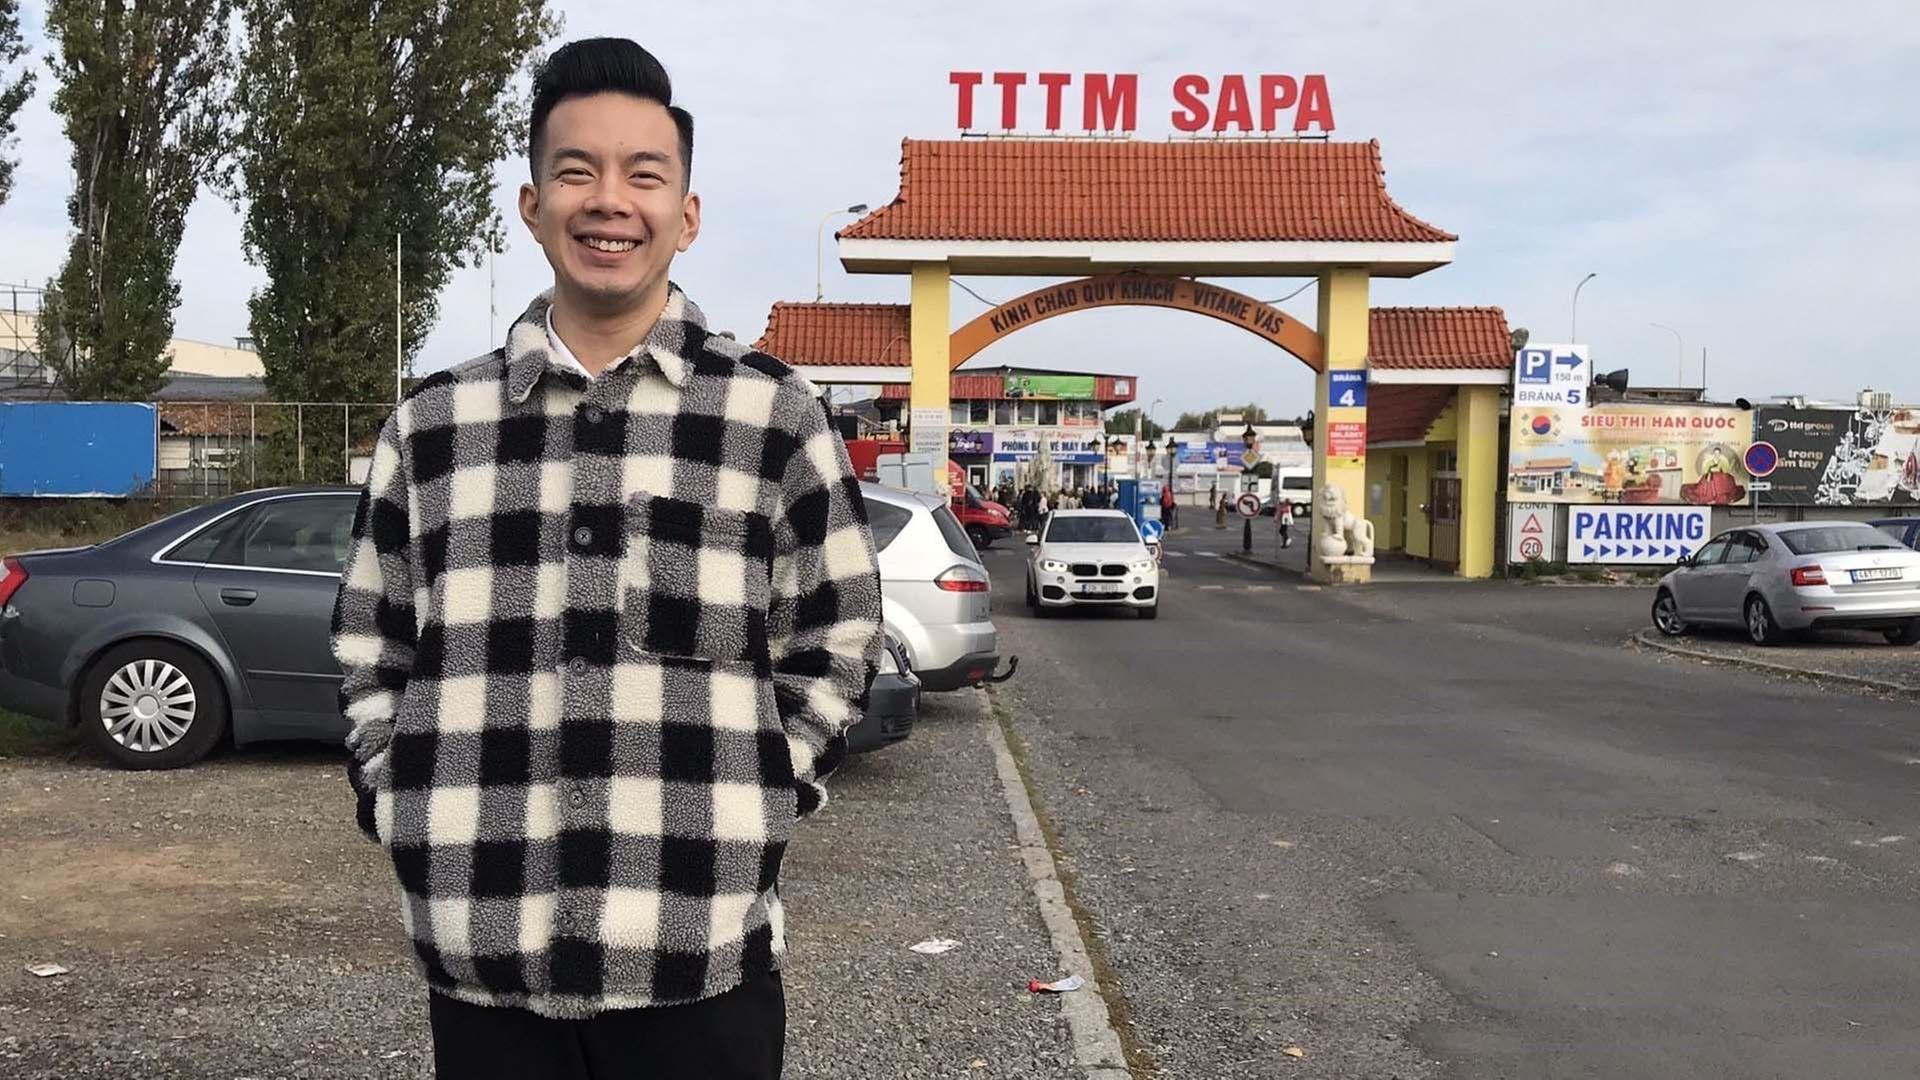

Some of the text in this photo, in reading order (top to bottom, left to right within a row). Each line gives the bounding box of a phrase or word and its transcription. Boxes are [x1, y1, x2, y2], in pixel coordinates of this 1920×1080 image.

[949, 72, 1335, 132] TTTM SAPA
[1526, 352, 1546, 375] P
[1555, 373, 1571, 381] 150
[1339, 389, 1356, 406] 4
[1519, 388, 1581, 404] BRÁNA 5
[1804, 422, 1834, 432] group
[1788, 448, 1824, 460] trong
[1798, 459, 1820, 470] tay
[1575, 512, 1704, 540] PARKING
[1524, 543, 1540, 555] 20
